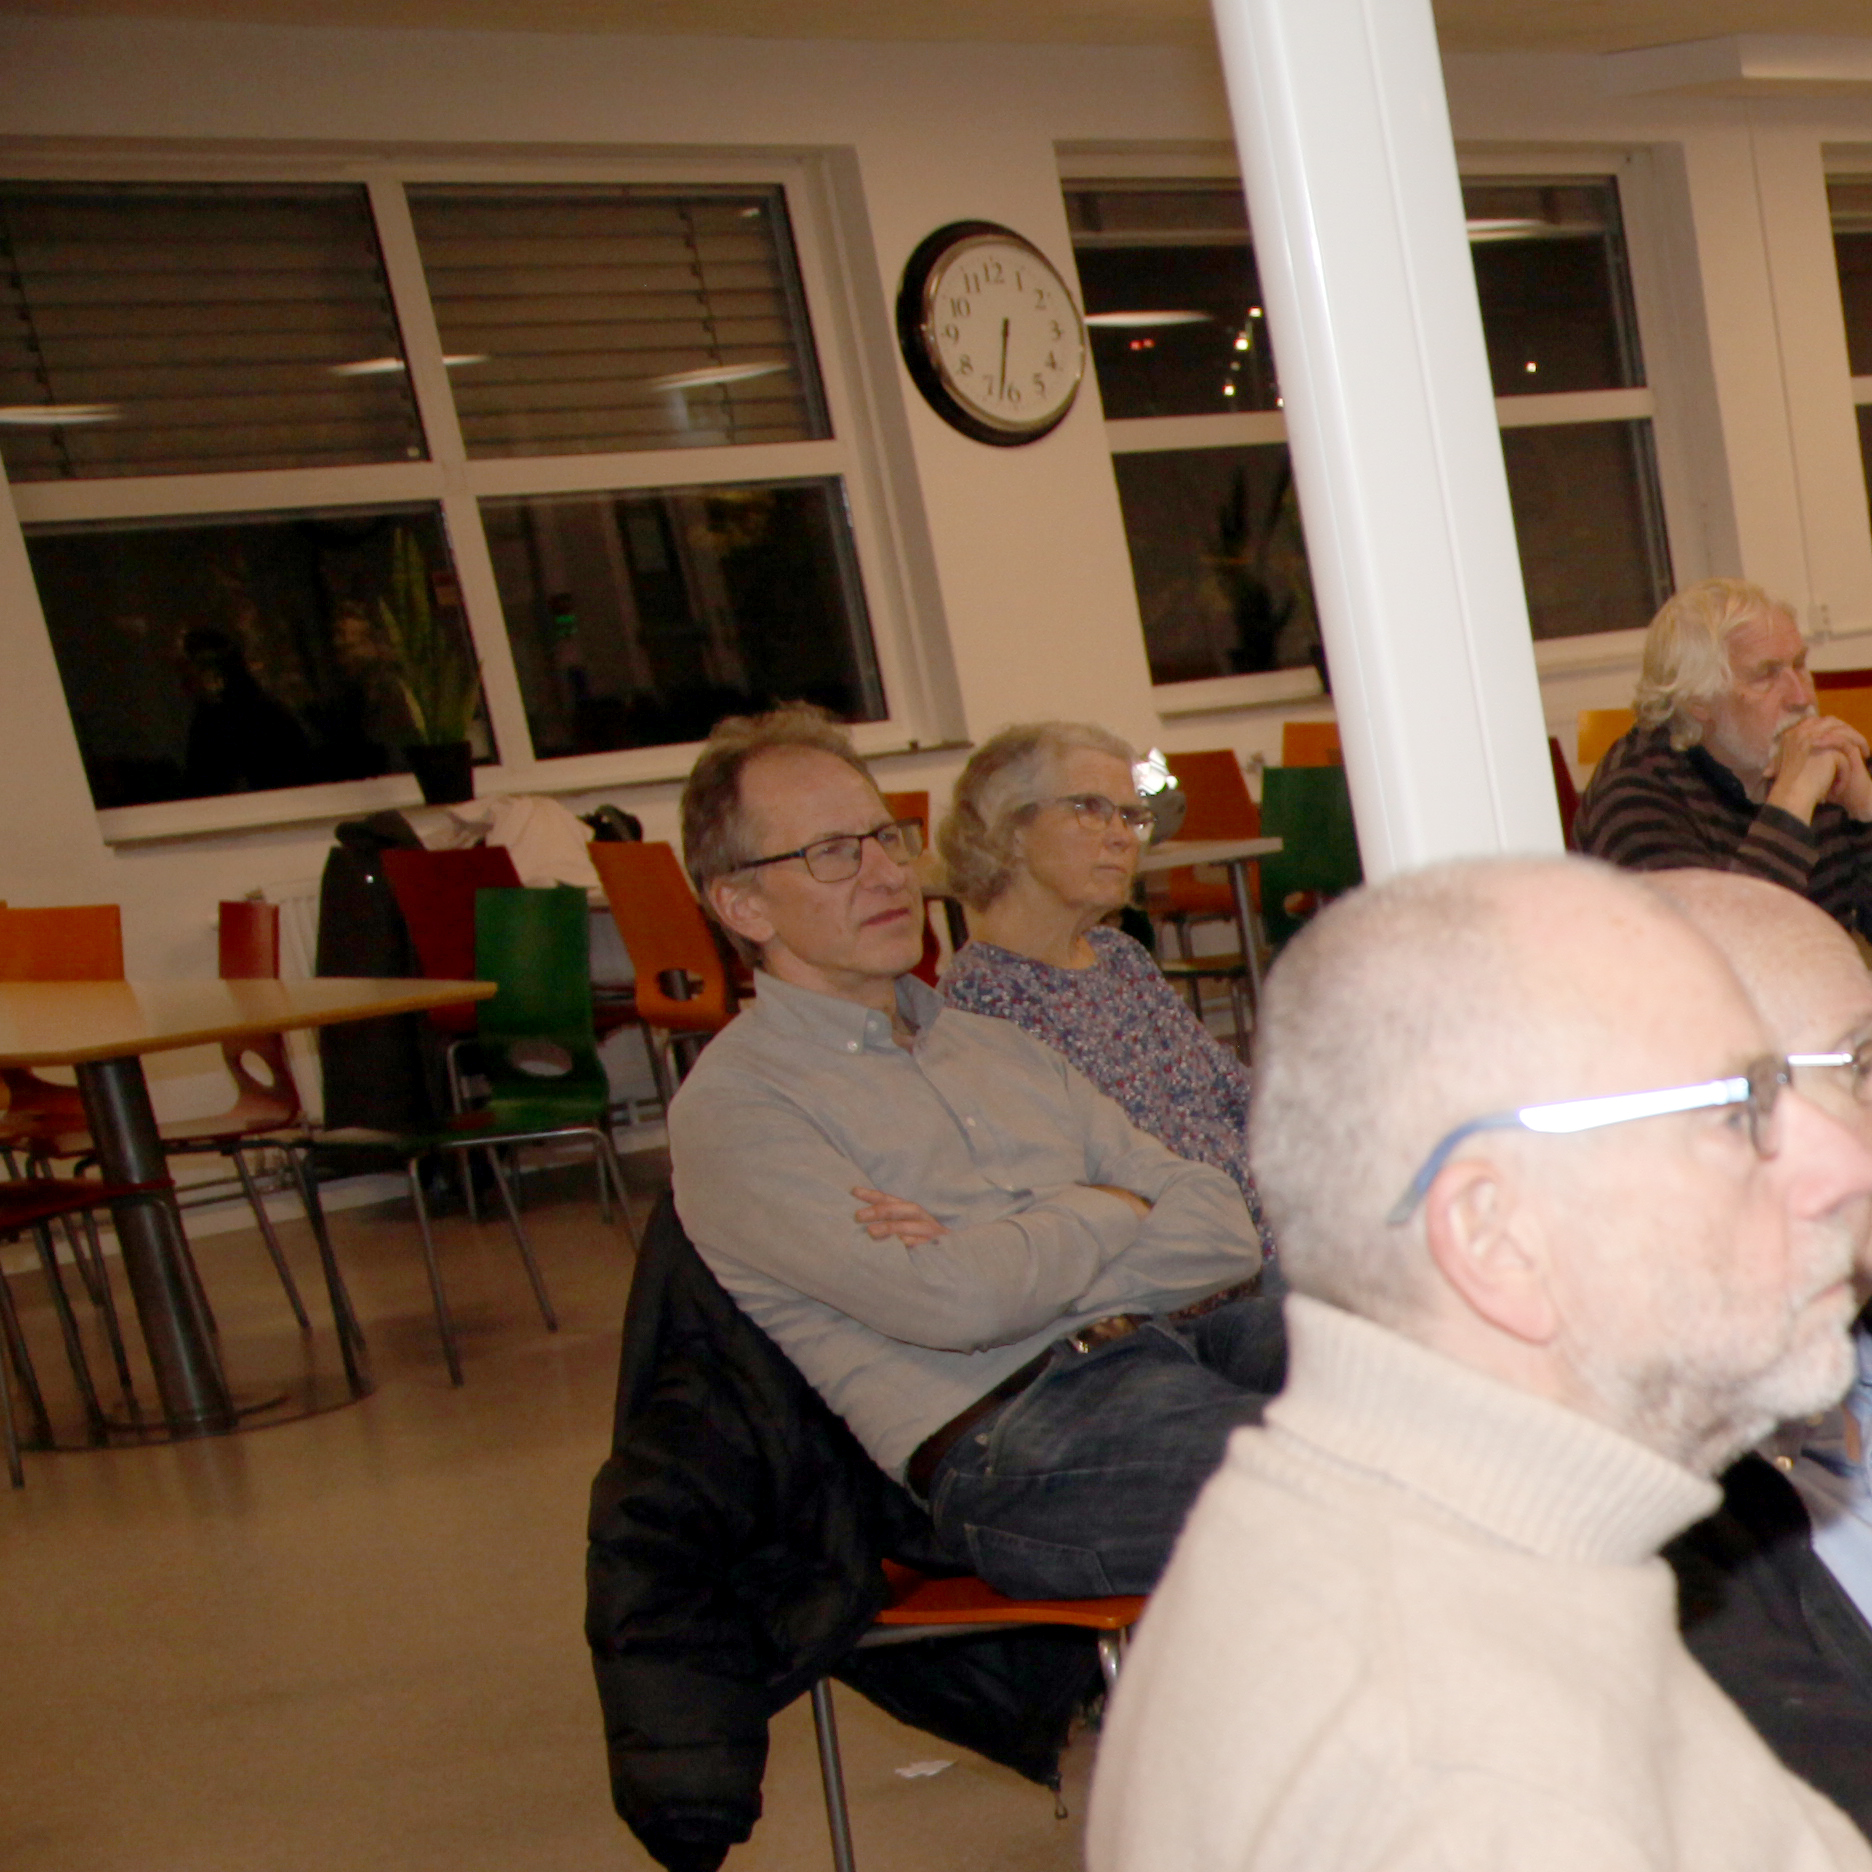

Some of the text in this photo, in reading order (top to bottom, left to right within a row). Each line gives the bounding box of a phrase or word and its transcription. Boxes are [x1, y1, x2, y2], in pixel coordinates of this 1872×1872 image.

[964, 272, 981, 294] 11
[983, 262, 1004, 284] 12
[950, 297, 971, 318] 10
[1034, 288, 1047, 310] 2
[945, 323, 959, 344] 9
[1050, 319, 1062, 341] 3
[959, 354, 973, 375] 8
[1044, 351, 1056, 370] 4
[982, 374, 993, 396] 7
[1007, 382, 1021, 403] 6
[1033, 372, 1045, 395] 5
